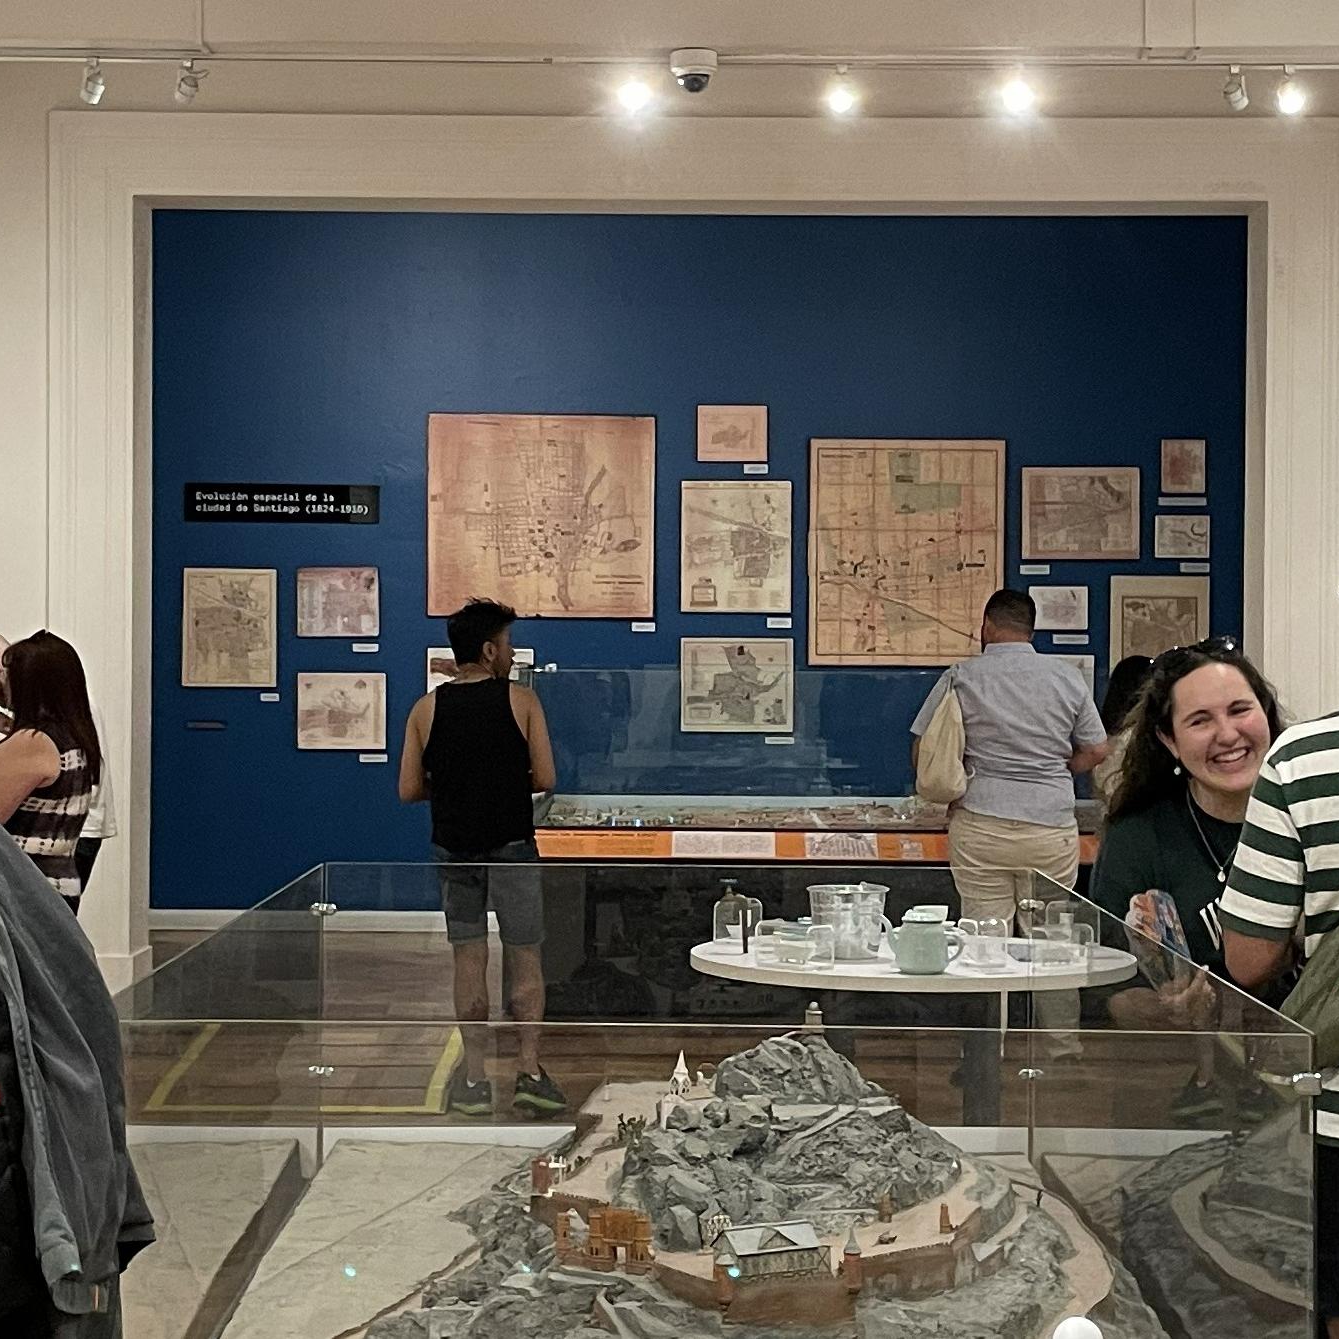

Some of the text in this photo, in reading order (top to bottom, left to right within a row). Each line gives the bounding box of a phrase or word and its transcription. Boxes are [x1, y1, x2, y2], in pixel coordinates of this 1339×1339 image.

[195, 491, 335, 503] Evolución espacial de la
[195, 503, 231, 513] ciudad
[236, 503, 248, 513] de
[253, 503, 300, 514] Santiago
